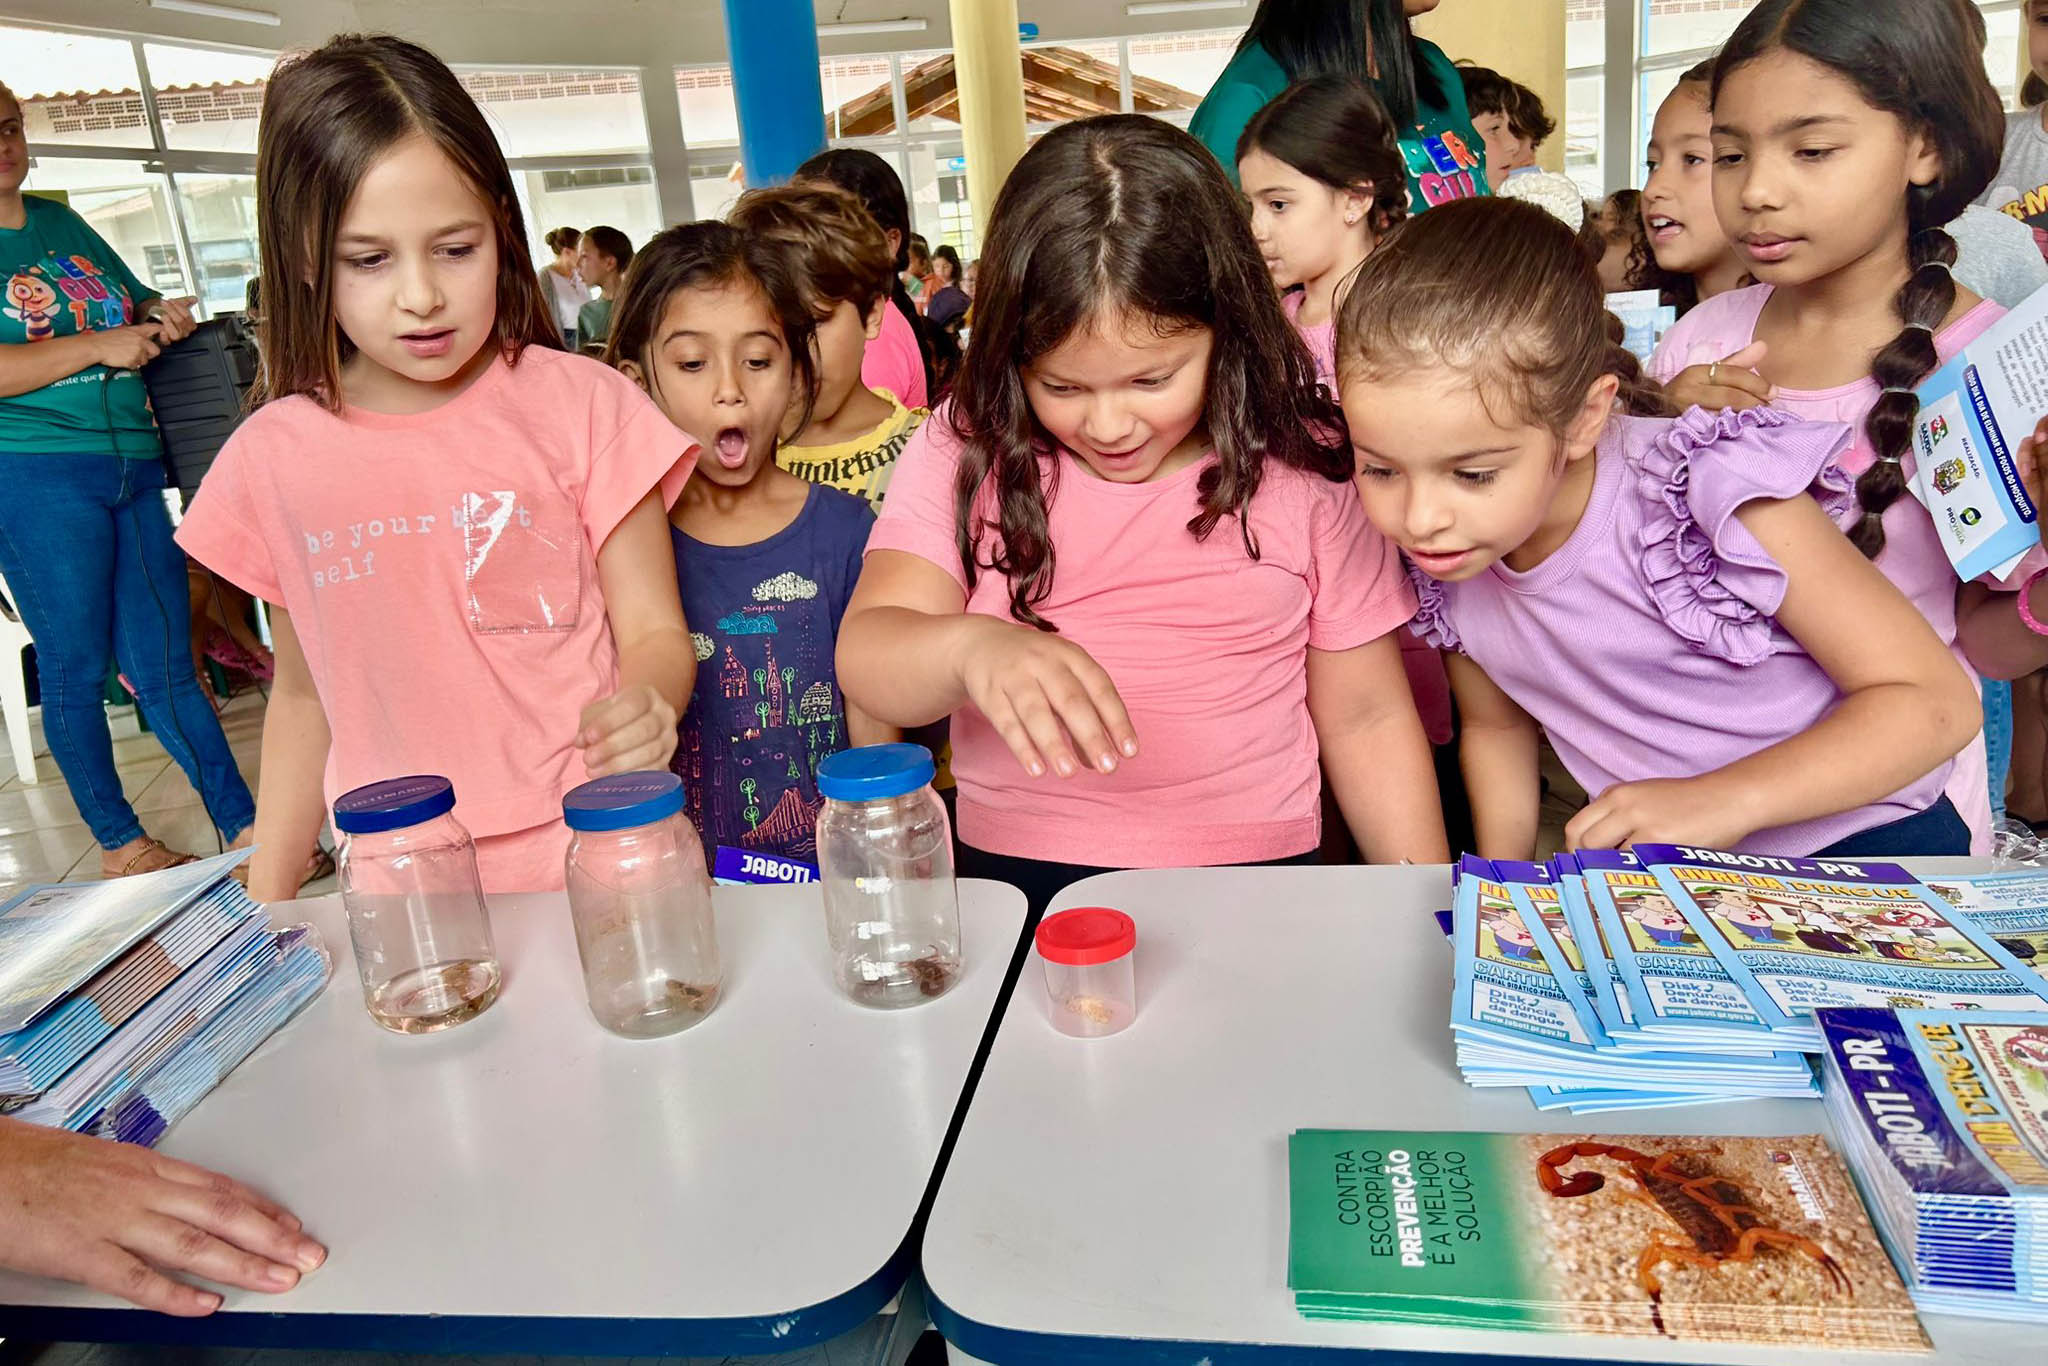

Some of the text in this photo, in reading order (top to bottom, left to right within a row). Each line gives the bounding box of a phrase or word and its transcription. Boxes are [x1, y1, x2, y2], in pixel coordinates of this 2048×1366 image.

[1971, 386, 1981, 397] DIA
[1976, 400, 1986, 413] DIA
[1980, 410, 1990, 421] DE
[1983, 419, 2001, 448] ELIMINAR
[1994, 446, 2005, 457] OS
[1998, 454, 2012, 477] FOCOS
[2006, 475, 2016, 485] DO
[2009, 482, 2033, 518] MOSQUITO.
[303, 503, 532, 555] be your bet
[313, 551, 376, 588] self
[741, 855, 810, 884] JABOTI
[1675, 847, 1797, 872] JABOTI
[1817, 861, 1869, 878] PR
[1669, 866, 1918, 900] LIVRE DA DENGUE
[1473, 973, 1506, 988] MATERIAL
[1738, 953, 1854, 975] CARTILHA
[1850, 963, 1889, 980] DO
[1887, 967, 2025, 987] PACOTINHO
[1489, 988, 1527, 1007] Disk
[1662, 980, 1700, 993] Disk
[1665, 988, 1737, 1002] Denúncia
[1488, 995, 1558, 1019] Denúncia
[1488, 1003, 1566, 1027] da dengue
[1667, 996, 1749, 1011] da dengue
[1842, 1037, 1896, 1071] PR
[1917, 1023, 2000, 1117] DENGUE
[1863, 1091, 1955, 1169] JABOTI
[1334, 1149, 1361, 1225] CONTRA
[1441, 1151, 1481, 1242] SOLUÇÃO
[1359, 1149, 1393, 1257] ESCORPIÃO
[1385, 1149, 1426, 1267] PREVENÇÃO
[1416, 1149, 1456, 1265] É A MELHOR
